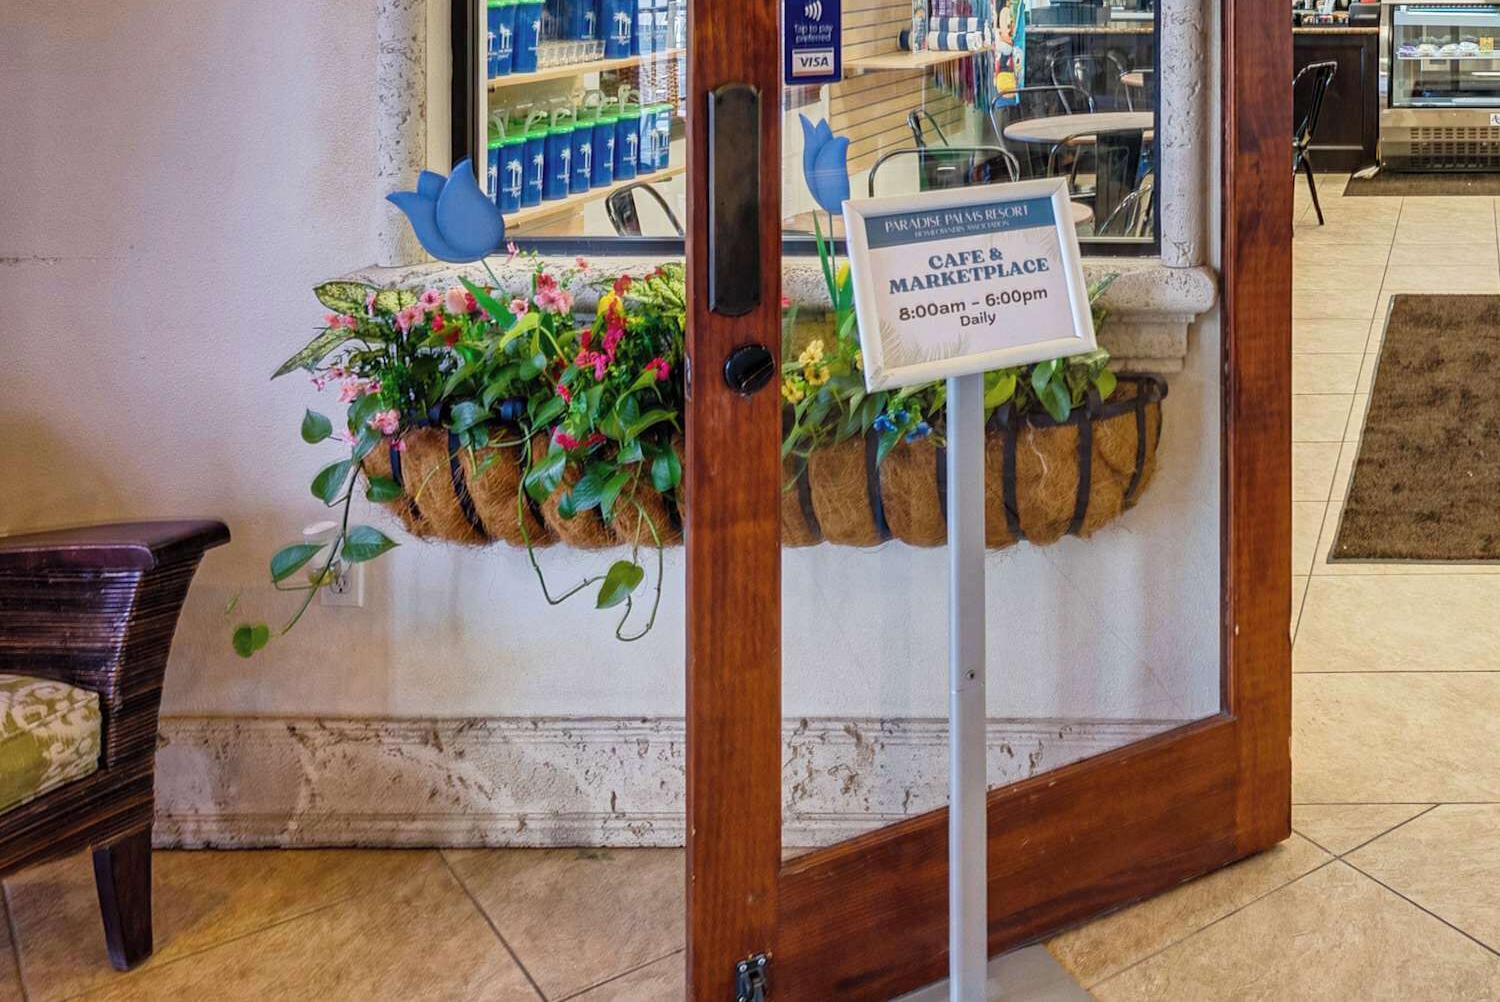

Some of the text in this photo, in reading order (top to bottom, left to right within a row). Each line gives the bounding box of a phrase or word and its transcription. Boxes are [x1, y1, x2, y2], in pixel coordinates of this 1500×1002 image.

[794, 24, 833, 36] Tap to pay
[800, 56, 829, 67] VISA
[885, 205, 1029, 232] PARADISE PALMS RESORT
[928, 248, 1003, 270] CAFE &
[889, 258, 1049, 295] MARKETPLACE
[899, 301, 966, 322] 8:00am
[985, 288, 1048, 308] 6:00pm
[960, 311, 997, 327] Daily
